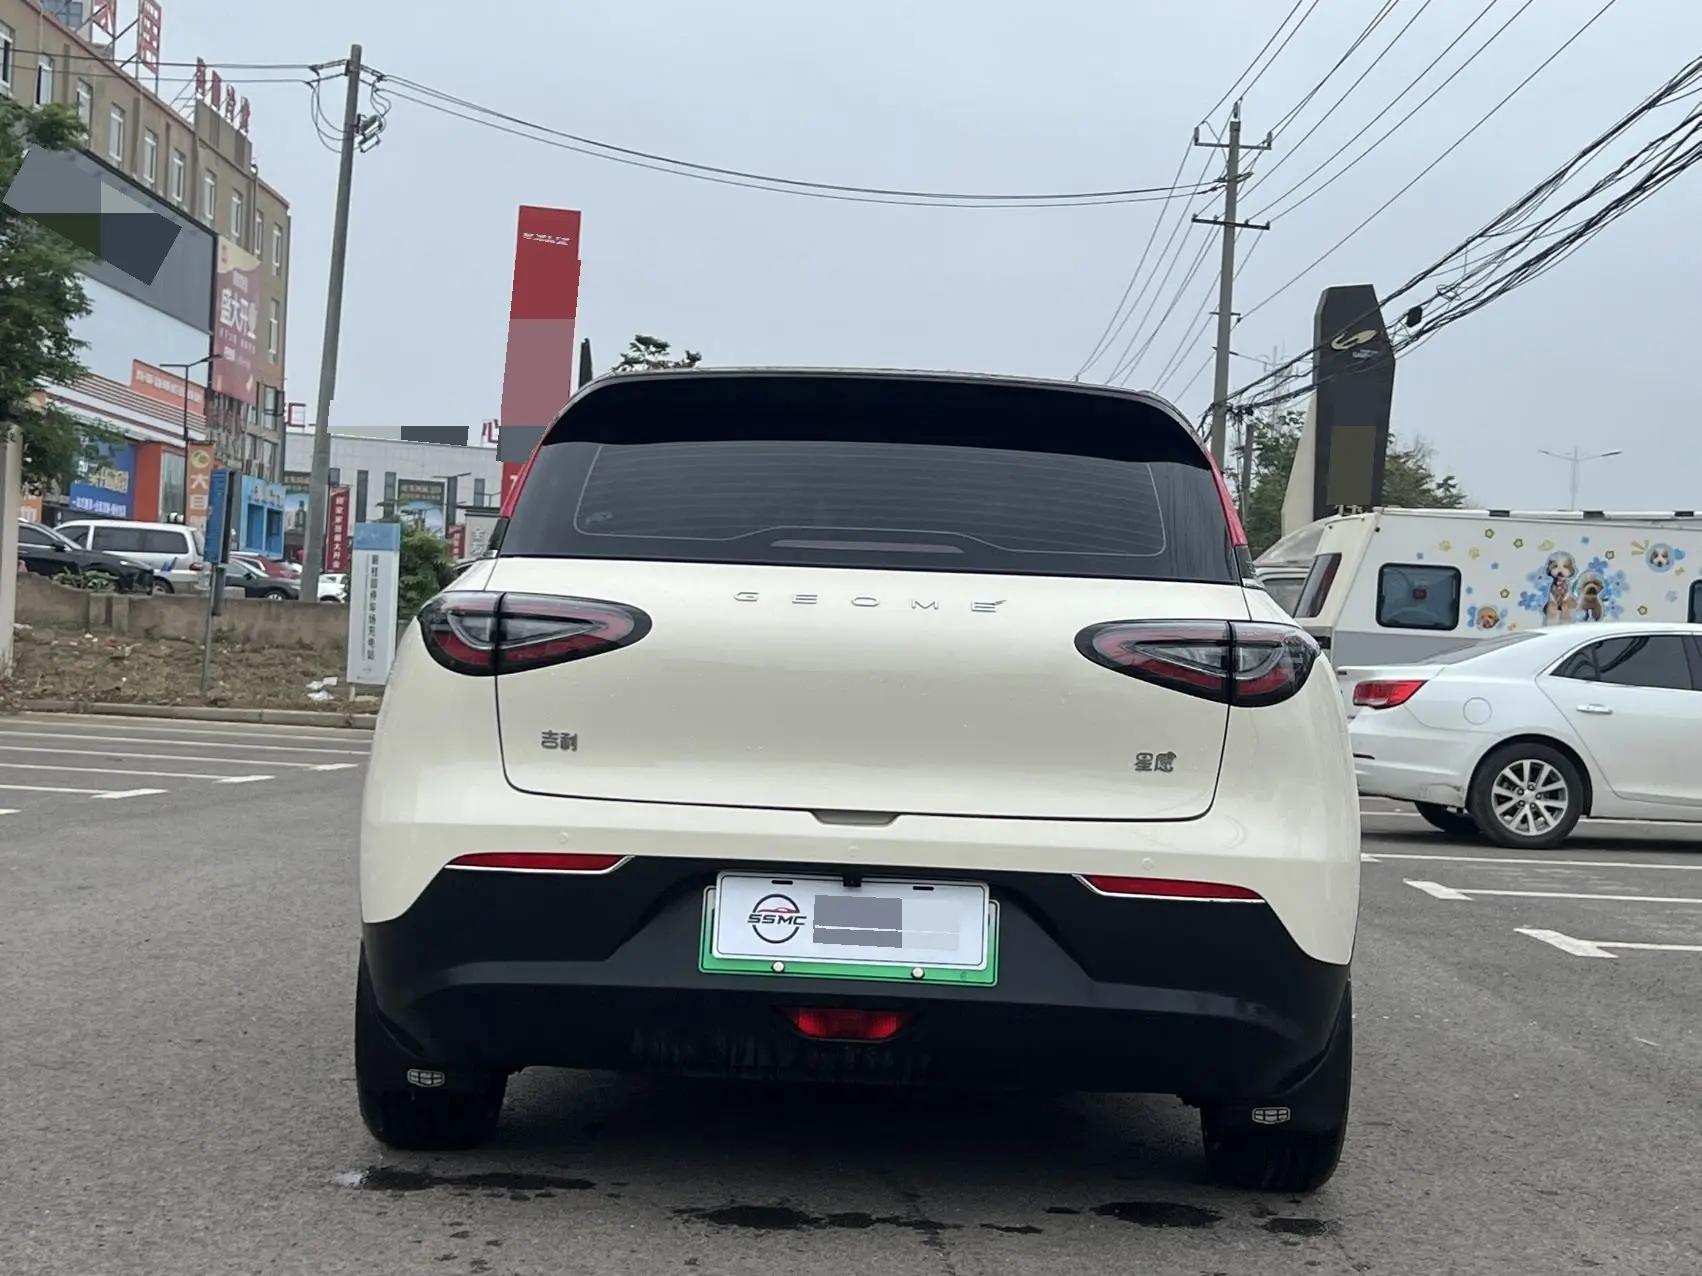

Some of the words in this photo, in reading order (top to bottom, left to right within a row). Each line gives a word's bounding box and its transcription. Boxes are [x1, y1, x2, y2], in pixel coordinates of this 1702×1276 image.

[734, 592, 1007, 613] GEOME
[542, 730, 577, 751] 吉利
[1135, 752, 1176, 772] 星愿
[748, 913, 807, 926] SSMC
